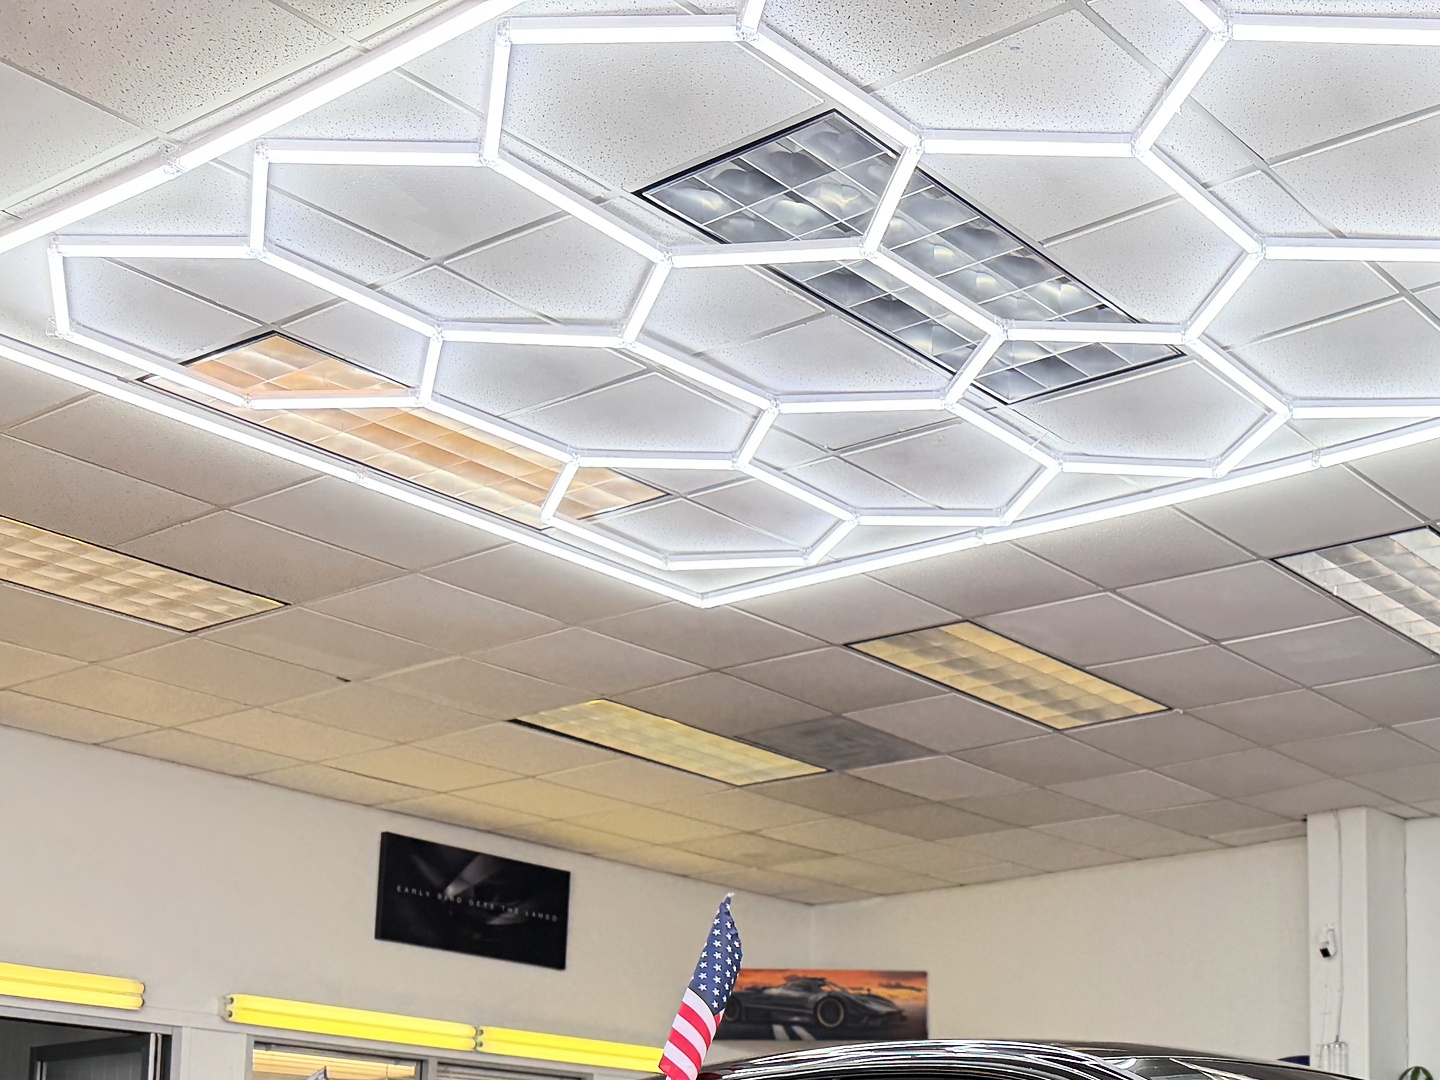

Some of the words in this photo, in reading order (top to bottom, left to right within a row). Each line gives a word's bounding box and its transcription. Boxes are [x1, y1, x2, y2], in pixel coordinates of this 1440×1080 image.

[396, 884, 430, 897] EARLY
[469, 899, 495, 910] GETS
[501, 905, 519, 915] THE
[525, 909, 557, 923] LAMBO
